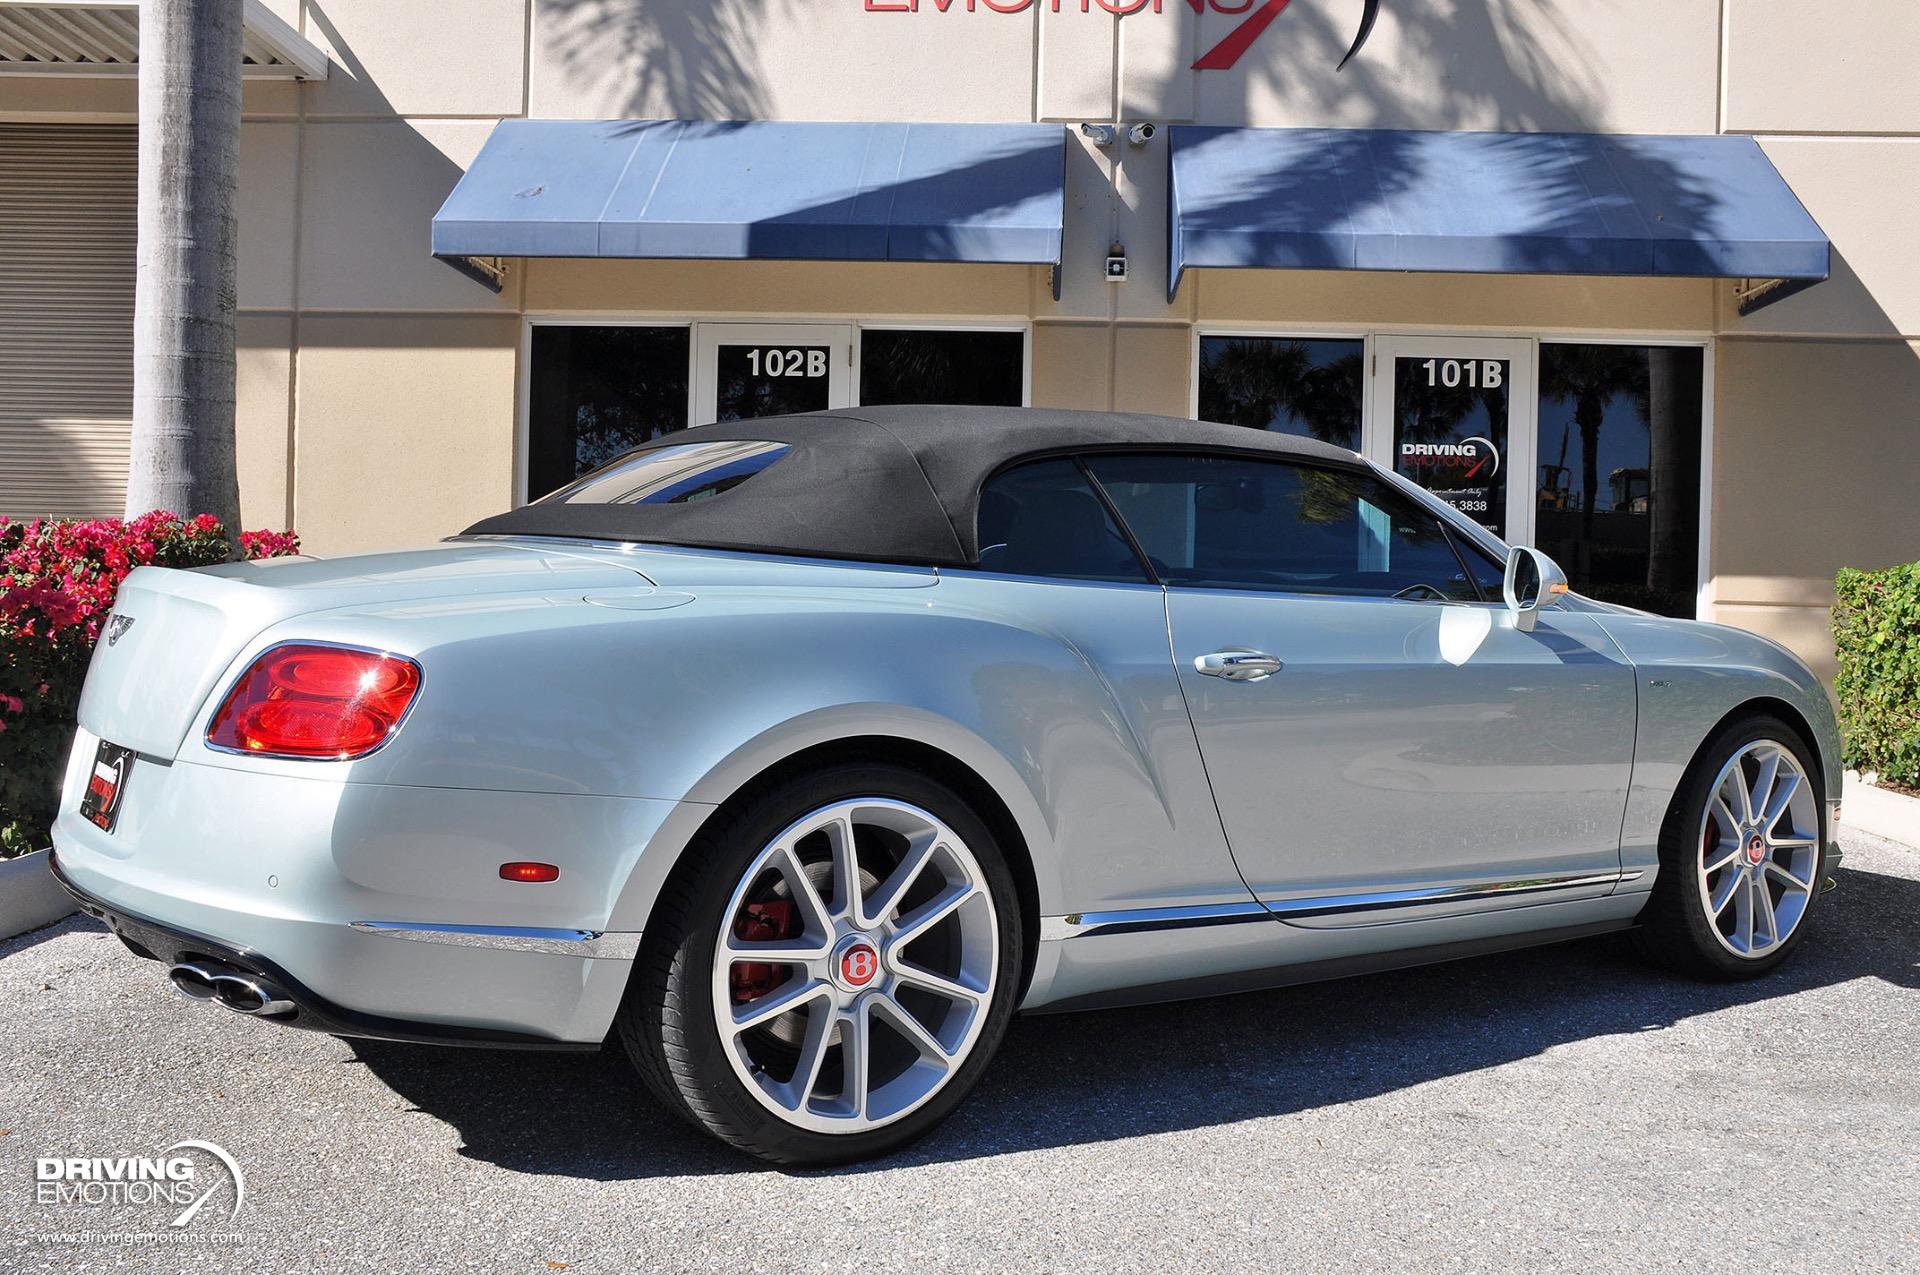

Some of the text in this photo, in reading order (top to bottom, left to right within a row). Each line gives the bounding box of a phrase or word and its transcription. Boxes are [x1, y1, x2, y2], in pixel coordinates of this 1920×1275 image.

[746, 349, 827, 378] 102B
[1422, 359, 1502, 388] 101B
[1402, 444, 1476, 456] DRIVING
[848, 950, 872, 978] B
